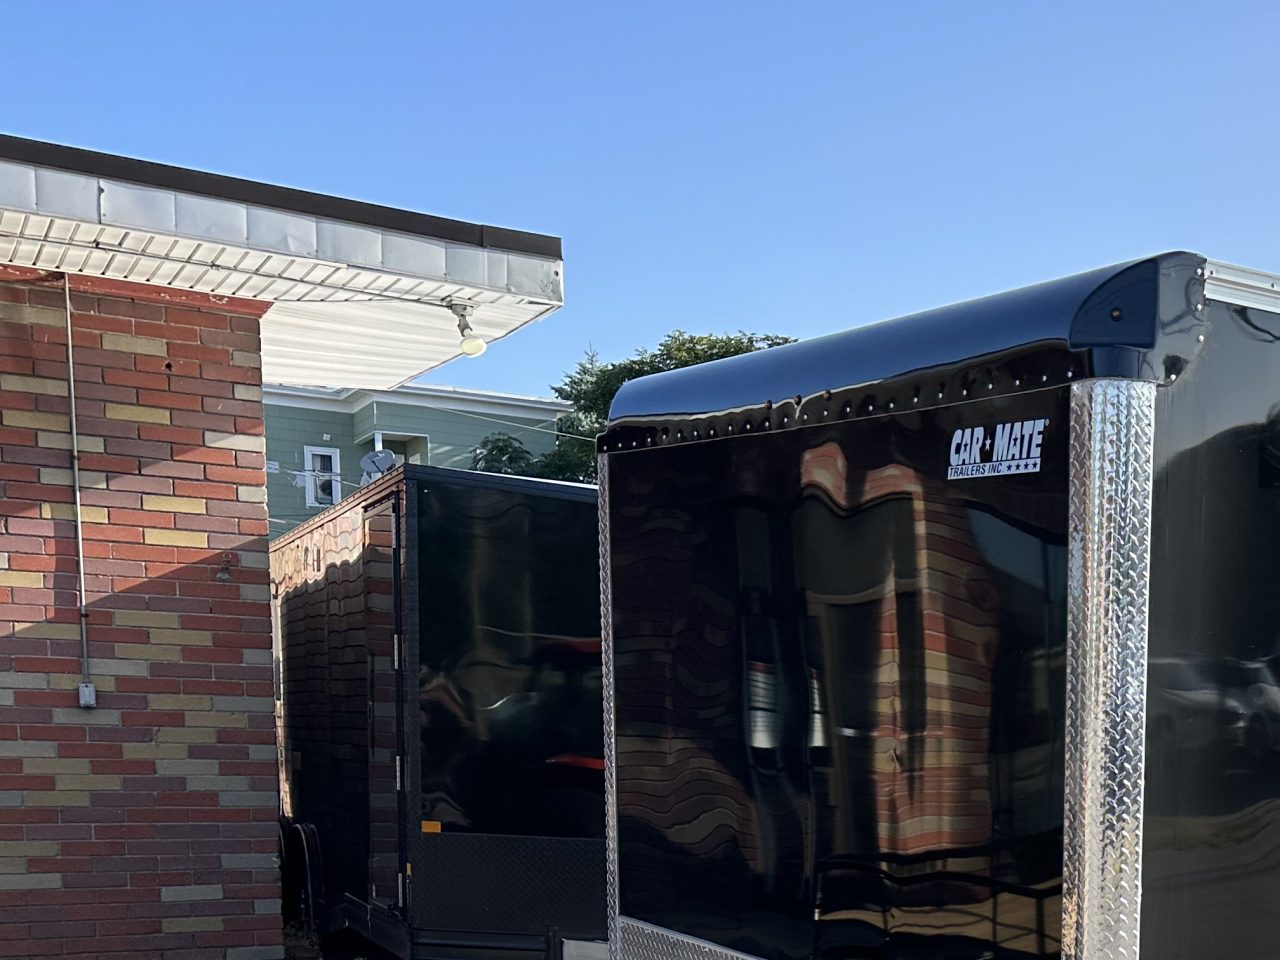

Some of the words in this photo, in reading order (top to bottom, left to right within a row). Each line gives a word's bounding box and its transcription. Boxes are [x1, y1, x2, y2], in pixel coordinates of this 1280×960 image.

[950, 427, 984, 466] CAR
[992, 419, 1045, 462] MATE
[949, 465, 986, 478] TRAILERS
